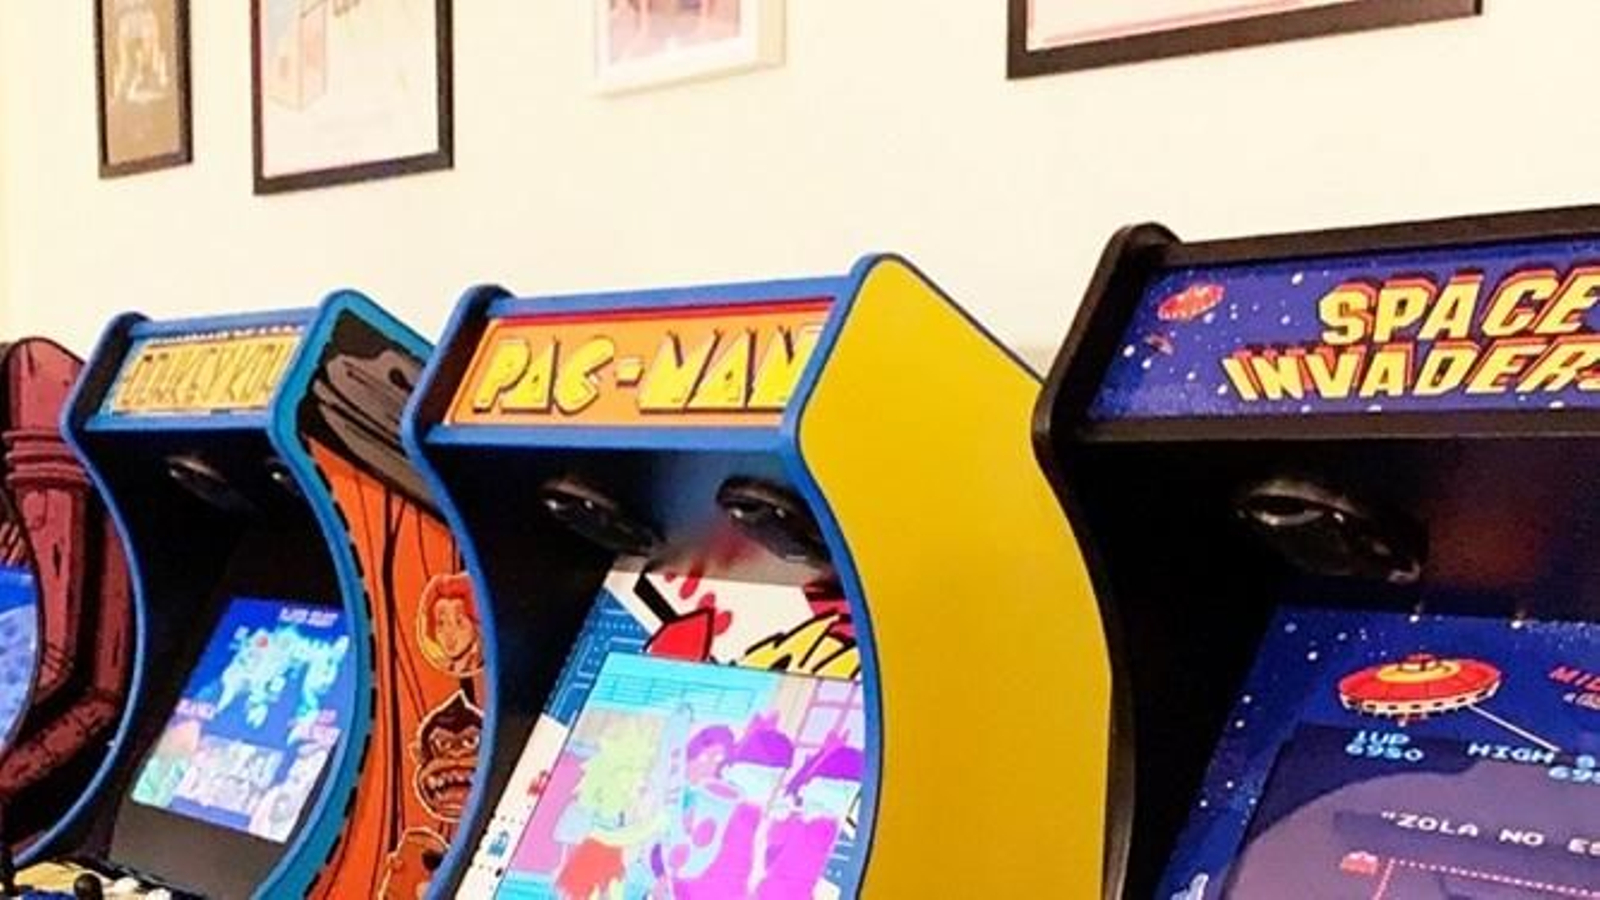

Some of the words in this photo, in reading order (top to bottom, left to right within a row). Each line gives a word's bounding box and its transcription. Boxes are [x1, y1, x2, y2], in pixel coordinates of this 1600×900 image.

[1319, 262, 1600, 346] SPACE
[472, 325, 822, 416] PAC-MAN
[1466, 742, 1555, 764] HIGH
[1499, 829, 1545, 847] NO
